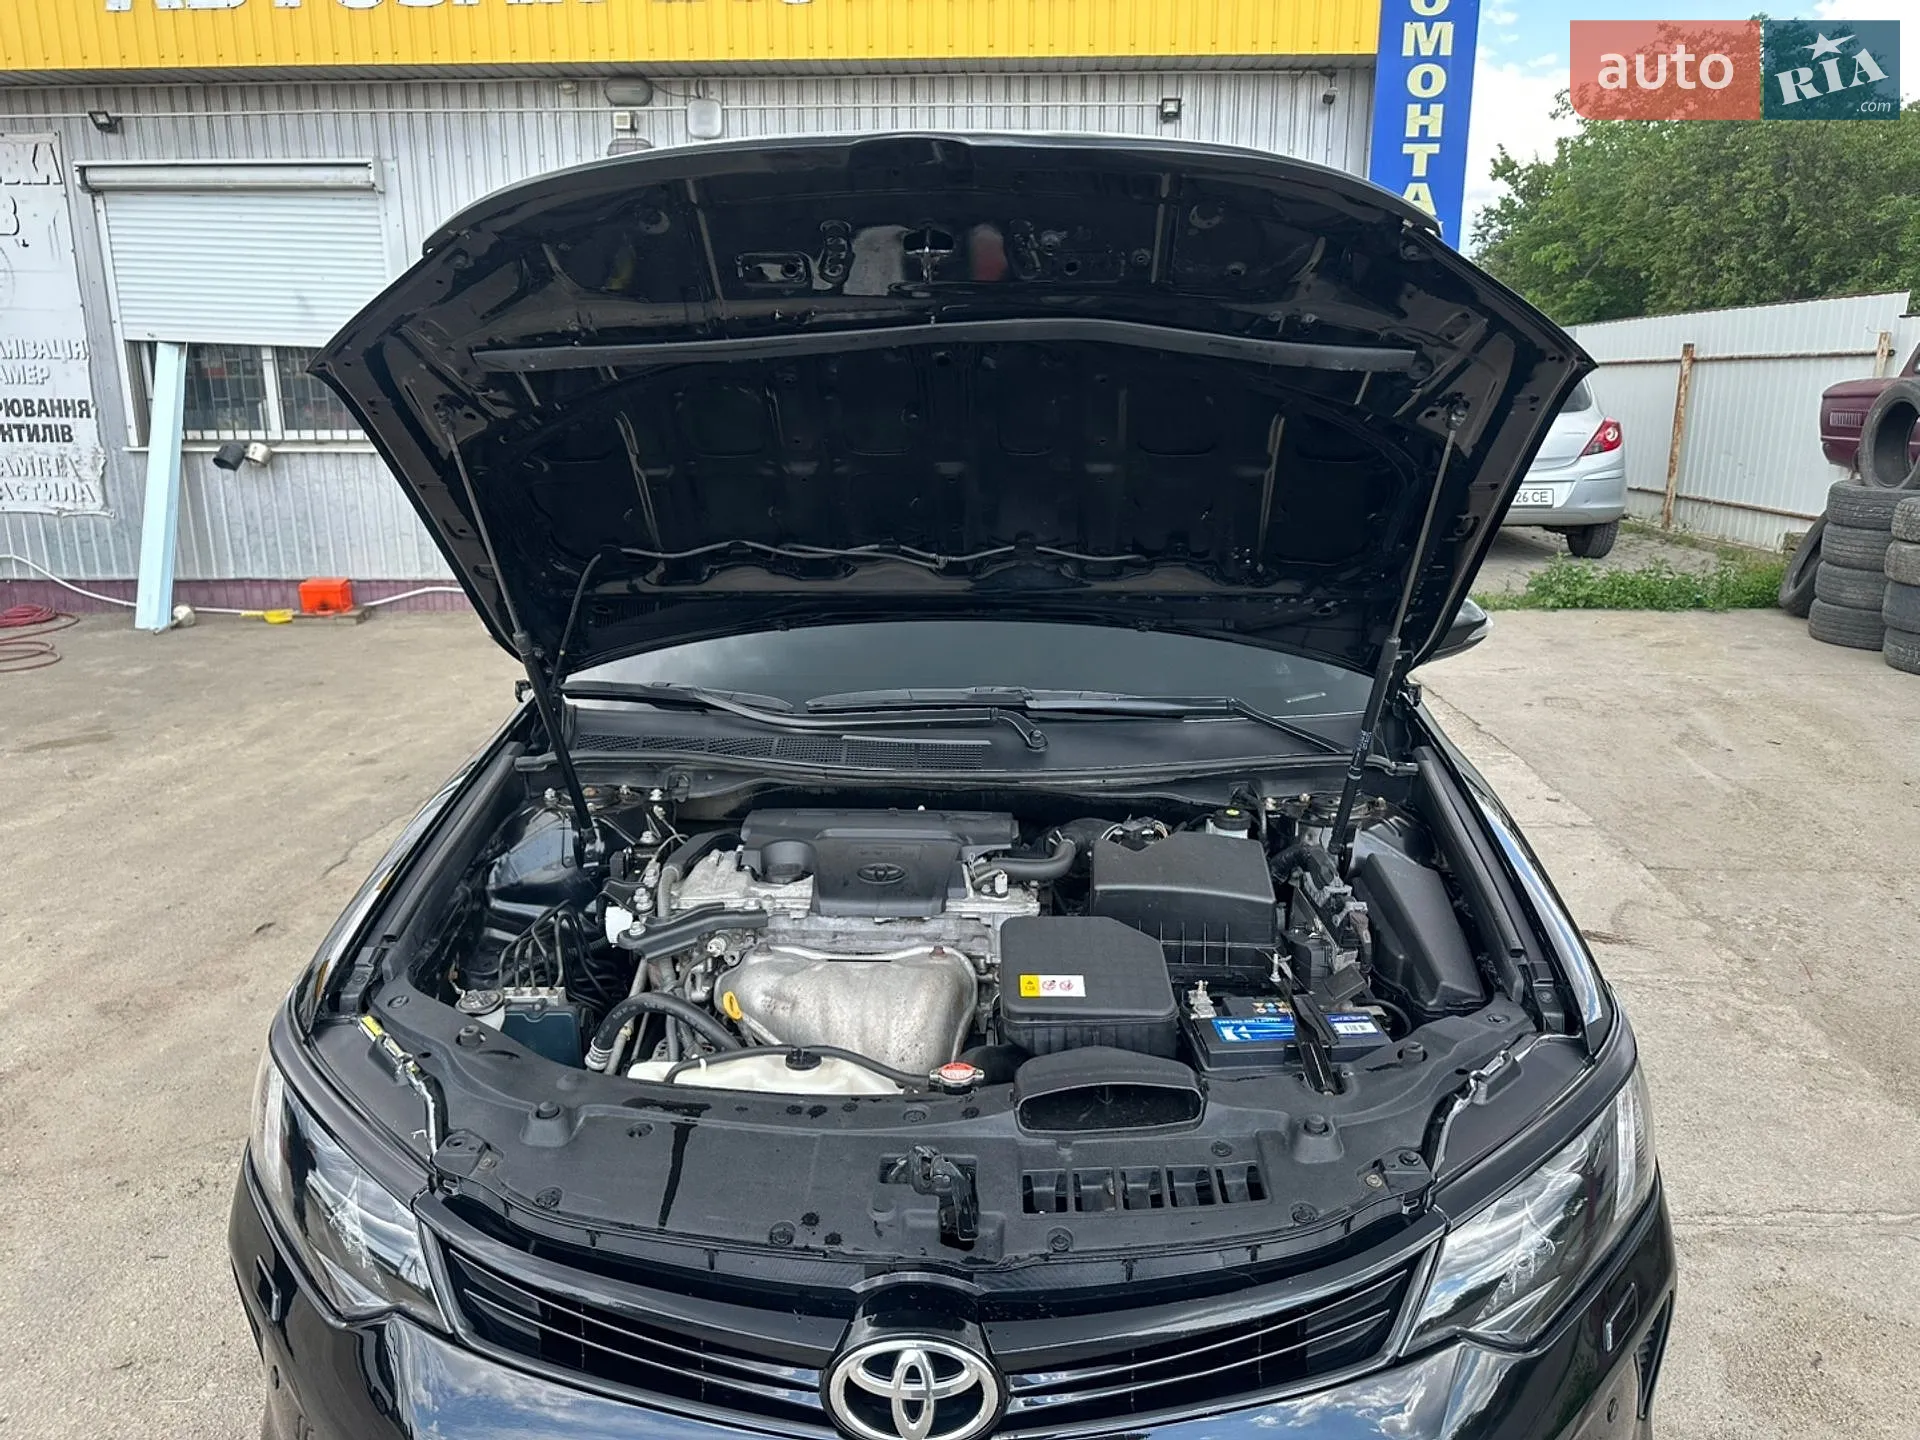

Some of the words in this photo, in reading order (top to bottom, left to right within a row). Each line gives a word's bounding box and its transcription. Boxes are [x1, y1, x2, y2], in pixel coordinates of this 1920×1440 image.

[1401, 0, 1455, 226] МОНТА
[0, 398, 92, 419] ЮВАННЯ
[1532, 490, 1549, 503] CE
